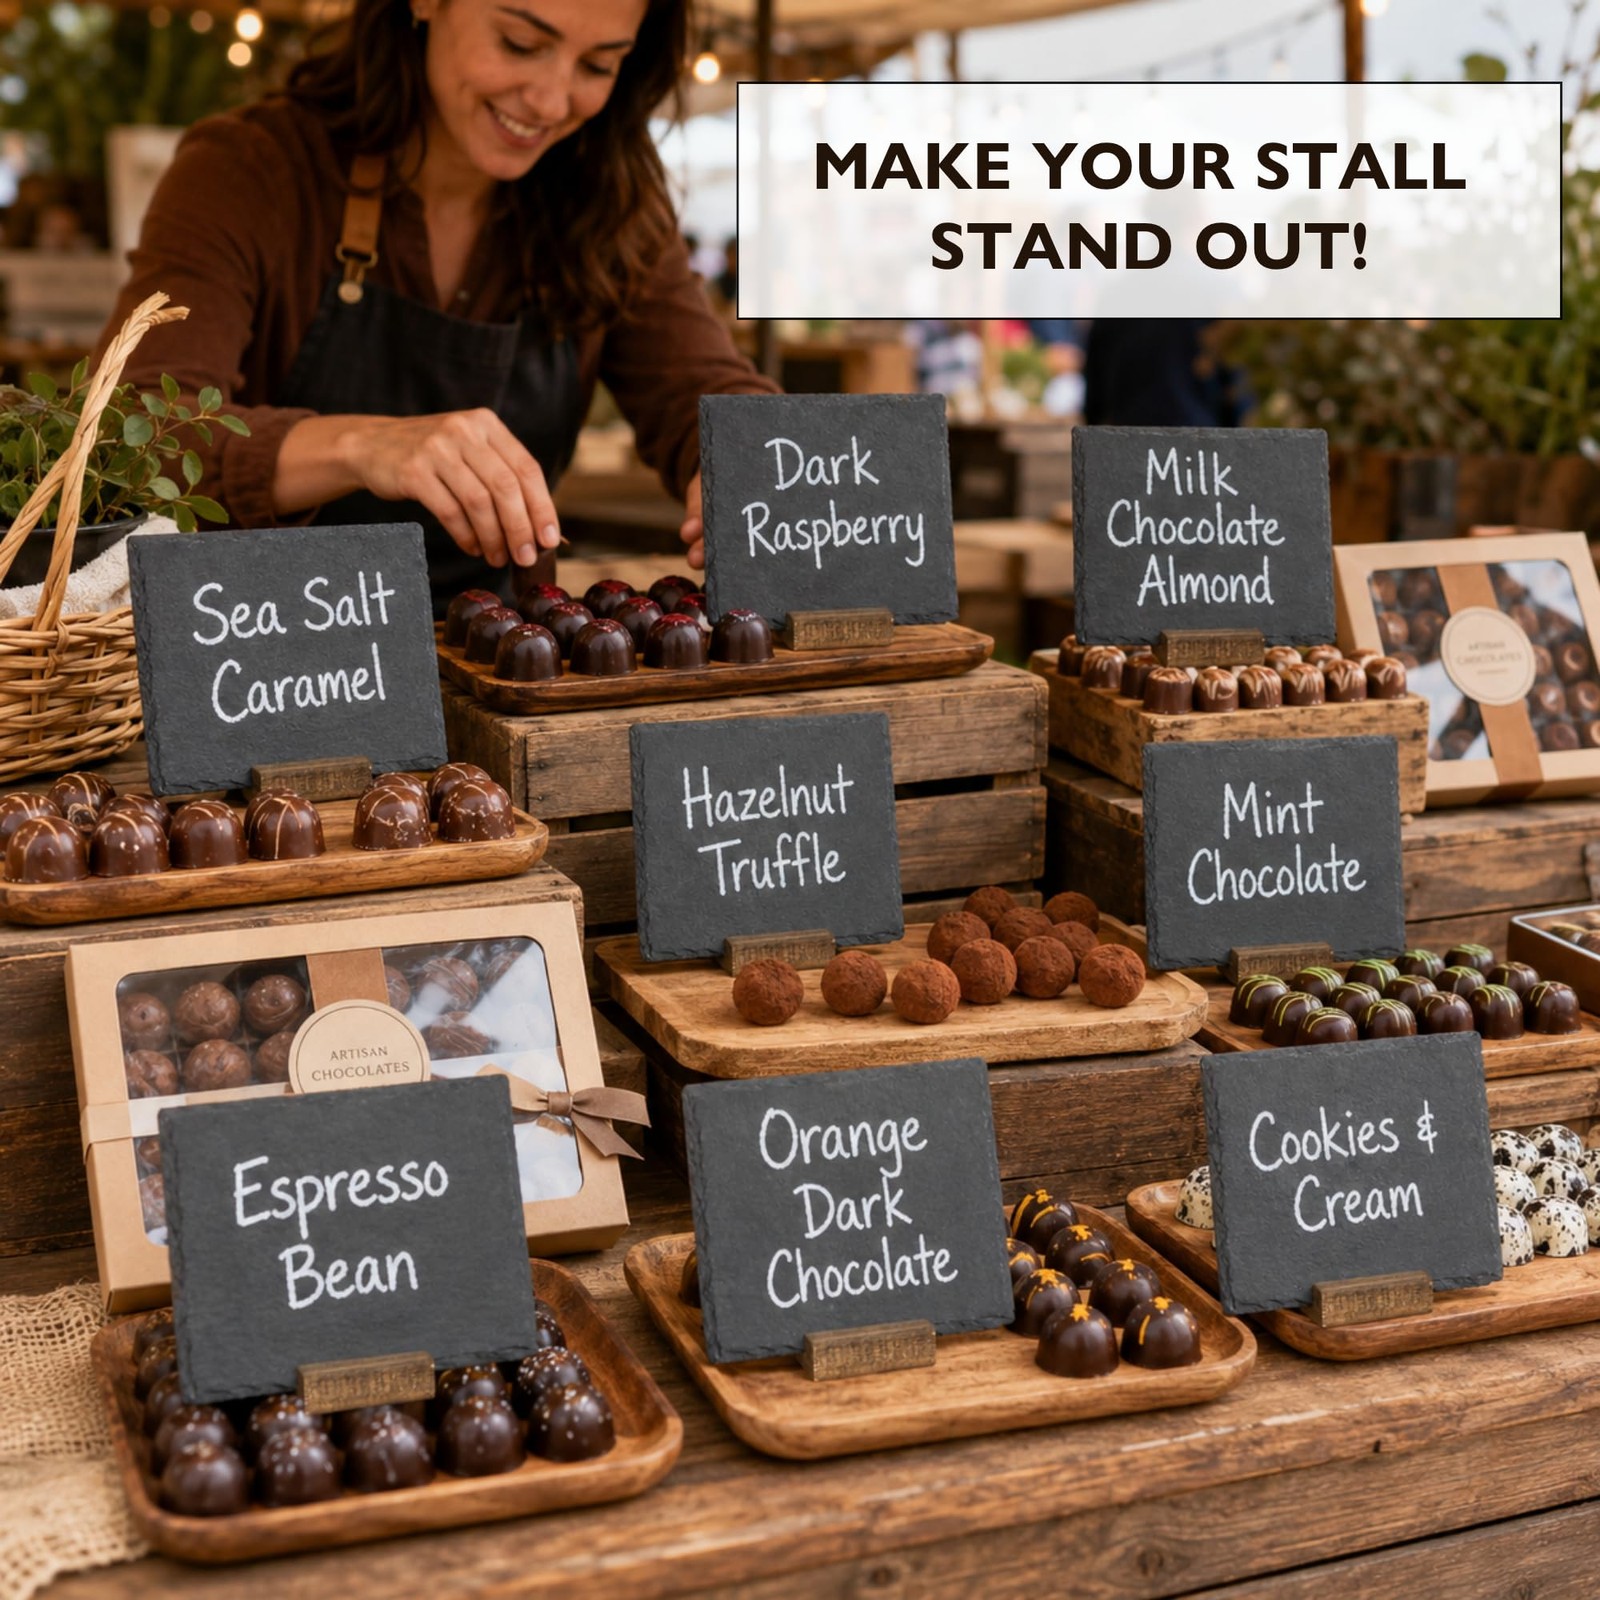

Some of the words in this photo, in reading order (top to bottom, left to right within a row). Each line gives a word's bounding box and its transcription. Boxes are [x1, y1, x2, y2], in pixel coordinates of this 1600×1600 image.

[764, 435, 880, 491] Dark
[1146, 446, 1239, 497] Milk
[741, 498, 926, 570] Raspberry
[1106, 498, 1286, 548] Chocolate
[192, 581, 288, 646] Sea
[303, 570, 396, 632] Salt
[1136, 553, 1275, 607] Almond
[210, 641, 387, 724] Caramel
[681, 762, 855, 830] Hazelnut
[1223, 781, 1325, 840] Mint
[697, 830, 847, 897] Truffle
[1187, 842, 1367, 906] Chocolate
[311, 1061, 410, 1081] CHOCOLATES
[330, 1046, 388, 1061] ARTISAN
[758, 1106, 929, 1178] Orange
[1248, 1105, 1401, 1172] Cookies
[1415, 1099, 1439, 1155] &
[232, 1155, 450, 1241] Espresso
[793, 1177, 913, 1239] Dark
[1293, 1173, 1424, 1233] Cream
[277, 1243, 419, 1311] Bean
[766, 1233, 959, 1309] Chocolate
